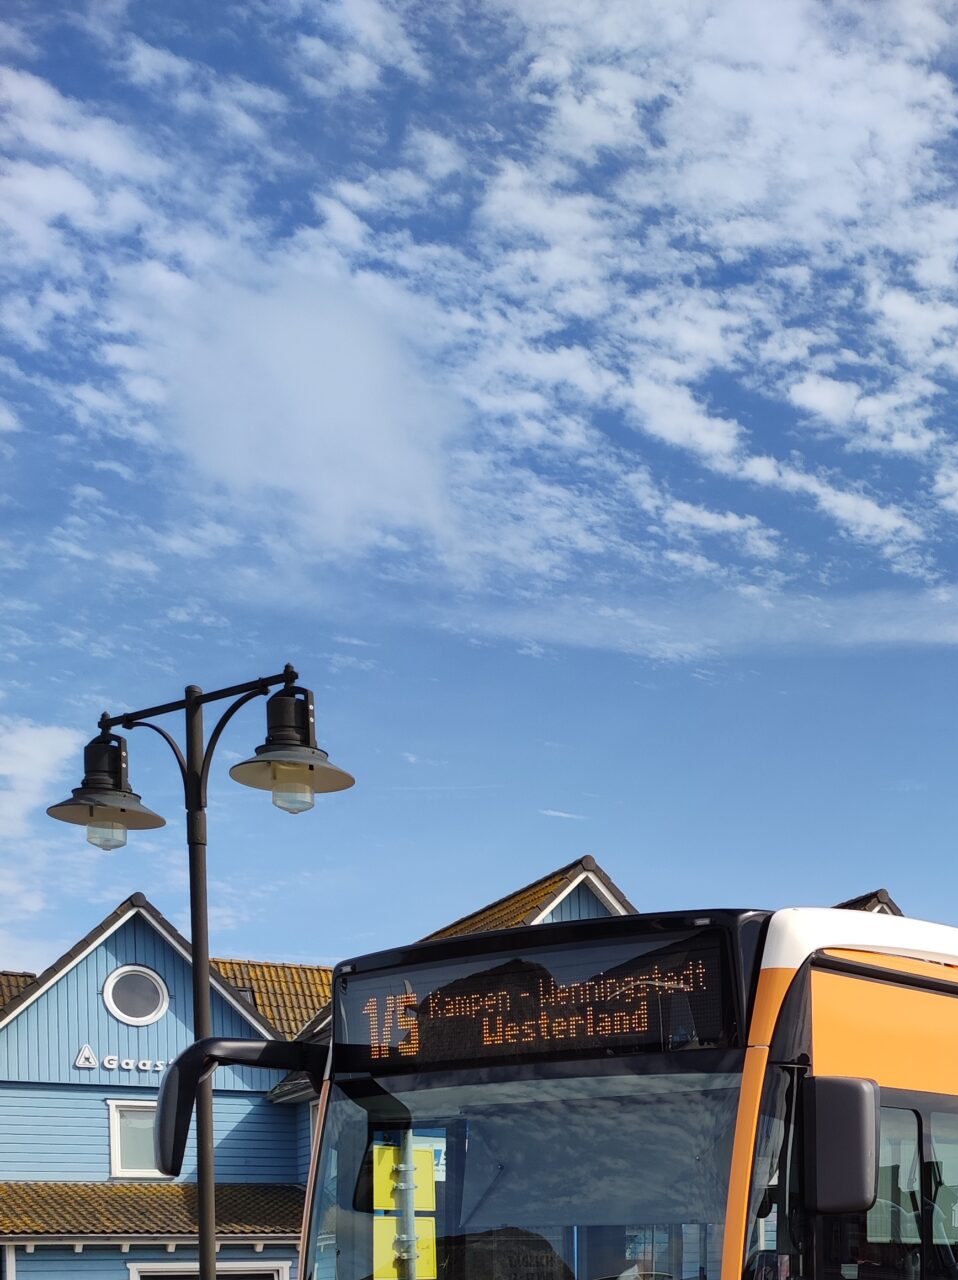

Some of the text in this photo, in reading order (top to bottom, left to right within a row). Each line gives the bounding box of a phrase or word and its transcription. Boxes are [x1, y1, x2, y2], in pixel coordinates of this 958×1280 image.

[428, 990, 511, 1019] Kampen
[538, 959, 707, 1007] Wenningstedt
[482, 1001, 649, 1045] Westerland
[102, 1055, 175, 1072] Gaas
